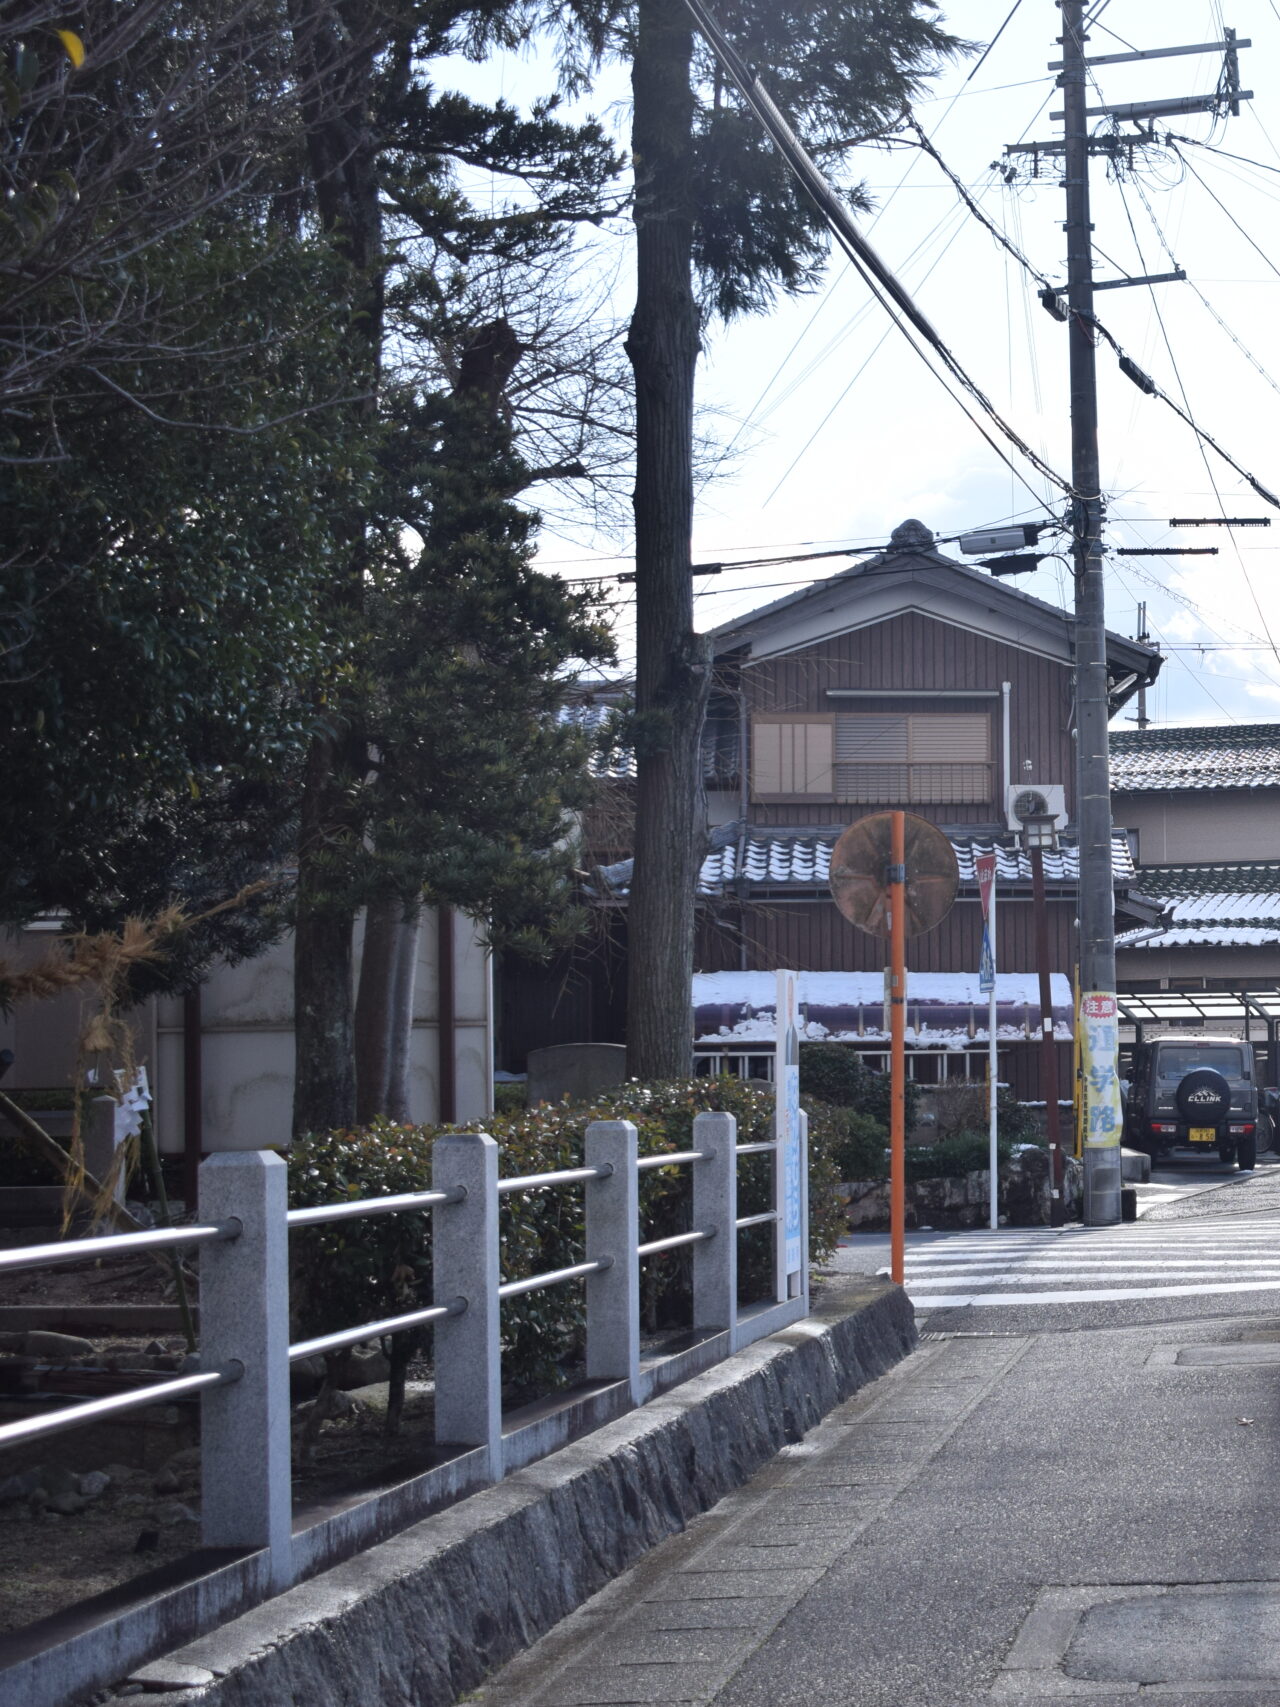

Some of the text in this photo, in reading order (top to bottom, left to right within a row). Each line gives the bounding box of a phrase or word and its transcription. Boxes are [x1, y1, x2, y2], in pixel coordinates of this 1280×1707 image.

[1086, 1000, 1113, 1014] 注意
[1088, 1024, 1116, 1133] 通学路
